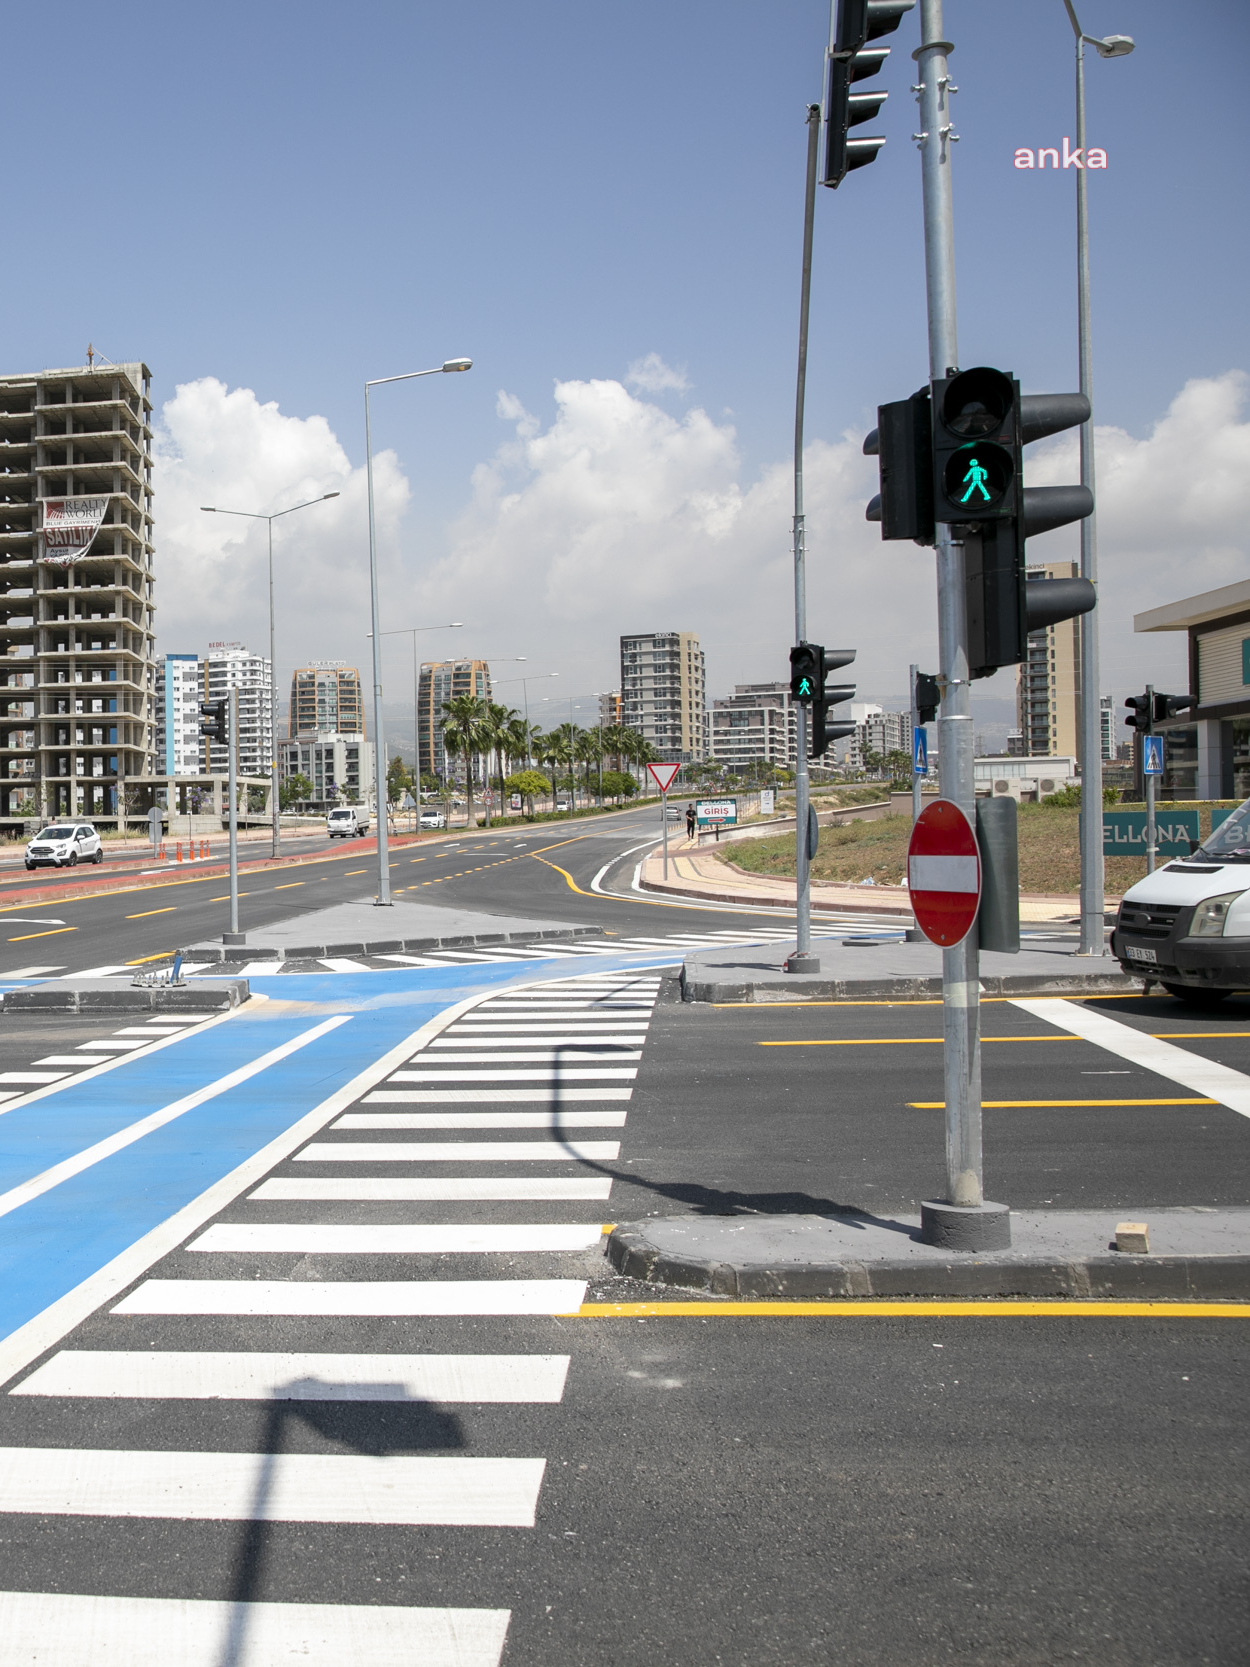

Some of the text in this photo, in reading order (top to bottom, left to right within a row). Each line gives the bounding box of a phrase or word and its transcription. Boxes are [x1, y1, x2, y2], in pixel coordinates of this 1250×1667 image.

[65, 499, 107, 510] REALTY
[46, 527, 92, 545] SATILIK
[704, 806, 729, 817] GİRİŞ
[1103, 825, 1190, 843] ELLONA
